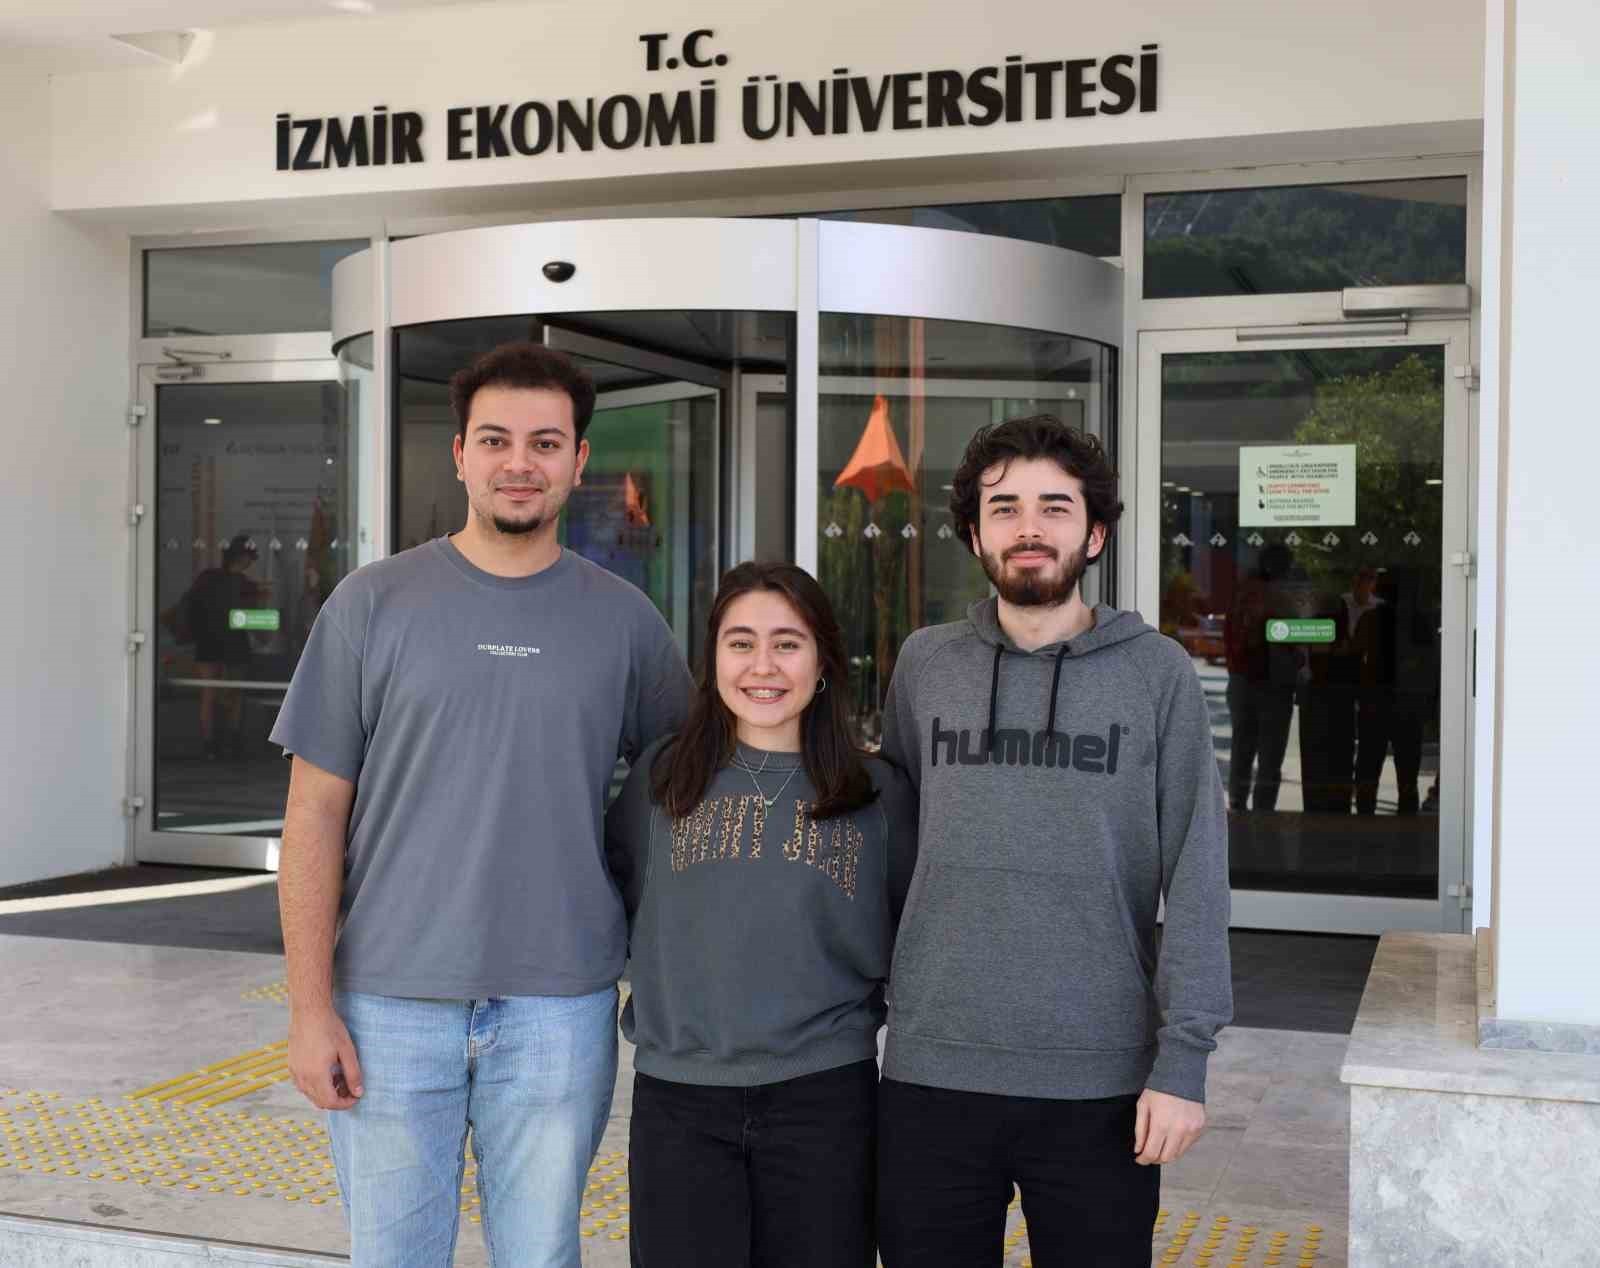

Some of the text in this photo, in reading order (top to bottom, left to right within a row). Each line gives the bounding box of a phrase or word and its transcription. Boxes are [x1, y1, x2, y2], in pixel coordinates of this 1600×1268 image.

[640, 29, 728, 71] T.C.
[276, 43, 1159, 171] İZMİR EKONOMİ ÜNİVERSİTESİ
[931, 716, 1121, 776] hummel
